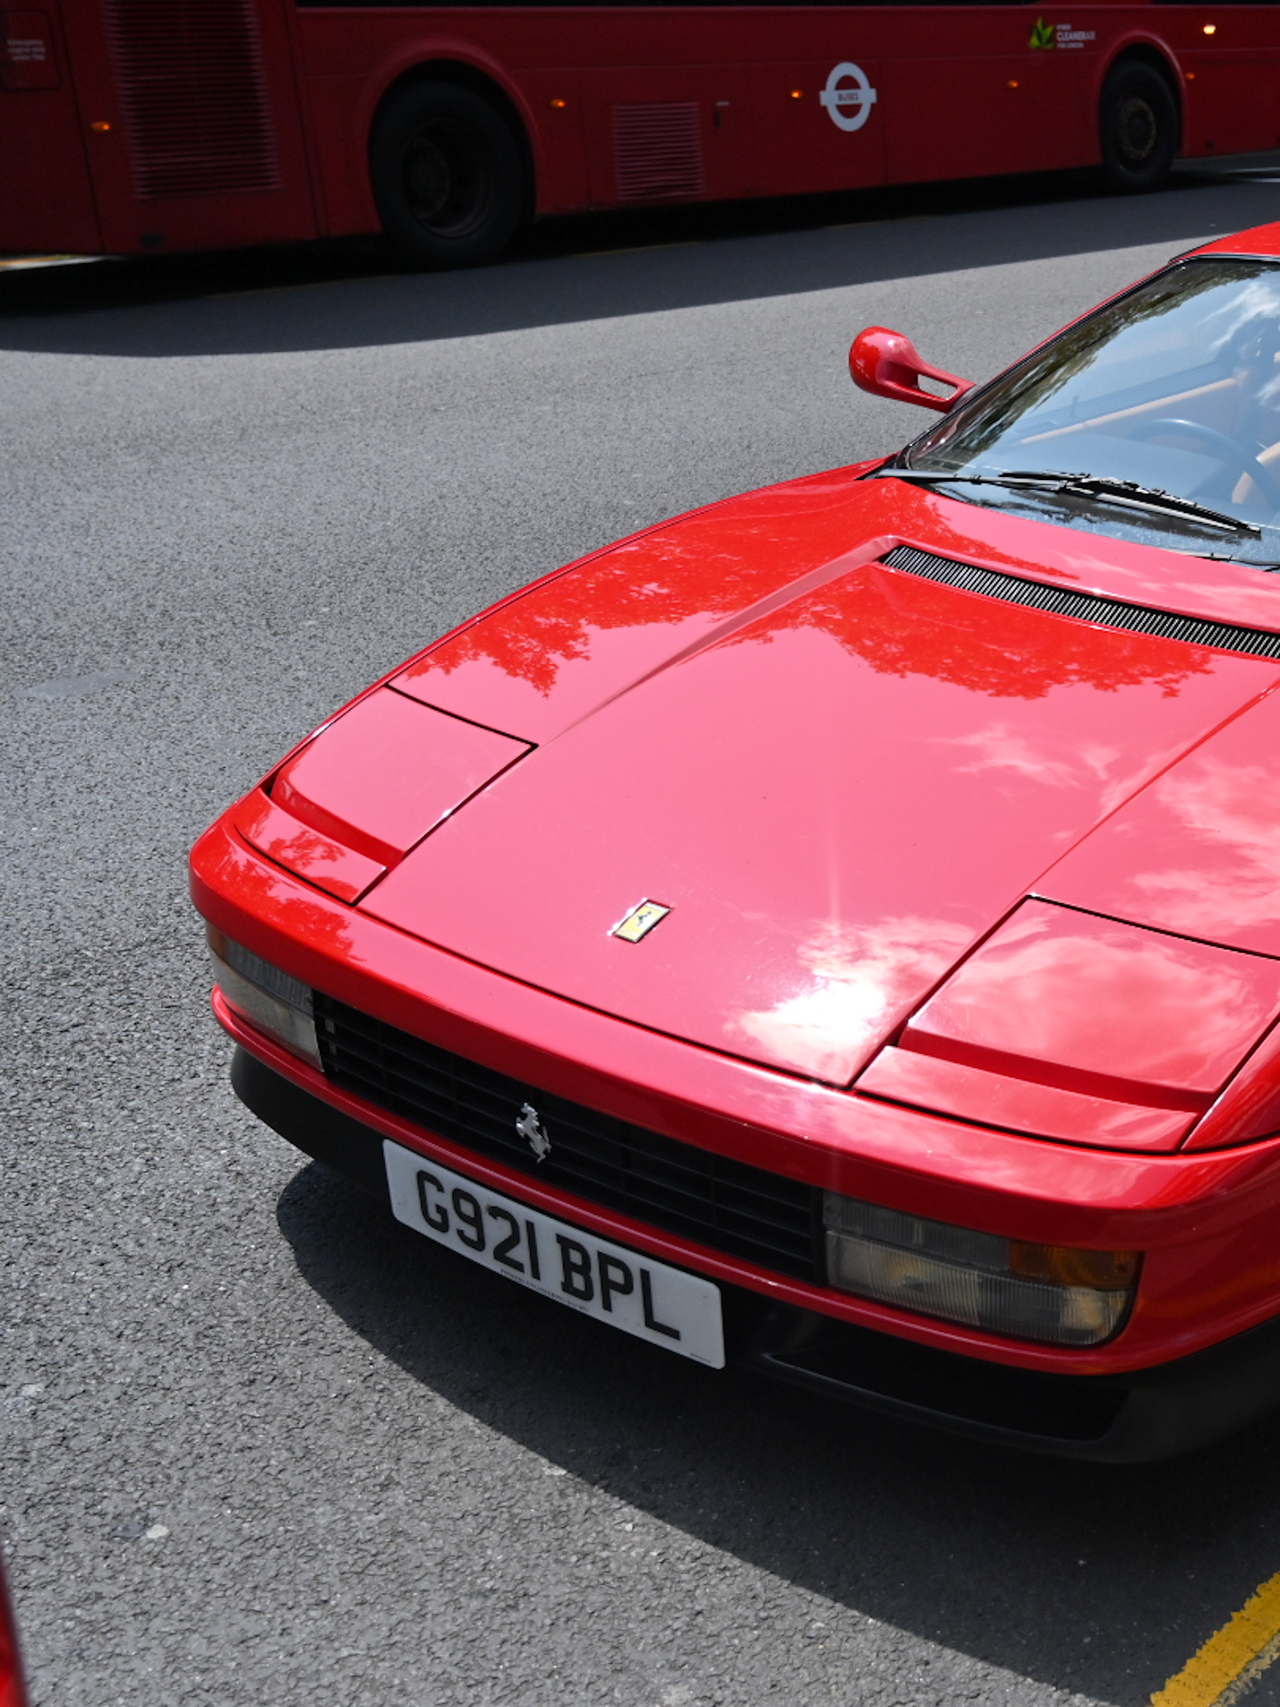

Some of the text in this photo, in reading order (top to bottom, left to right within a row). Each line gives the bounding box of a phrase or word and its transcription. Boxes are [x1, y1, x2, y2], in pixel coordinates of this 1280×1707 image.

[838, 92, 859, 101] BUSES
[416, 1169, 682, 1341] G921 BPL
